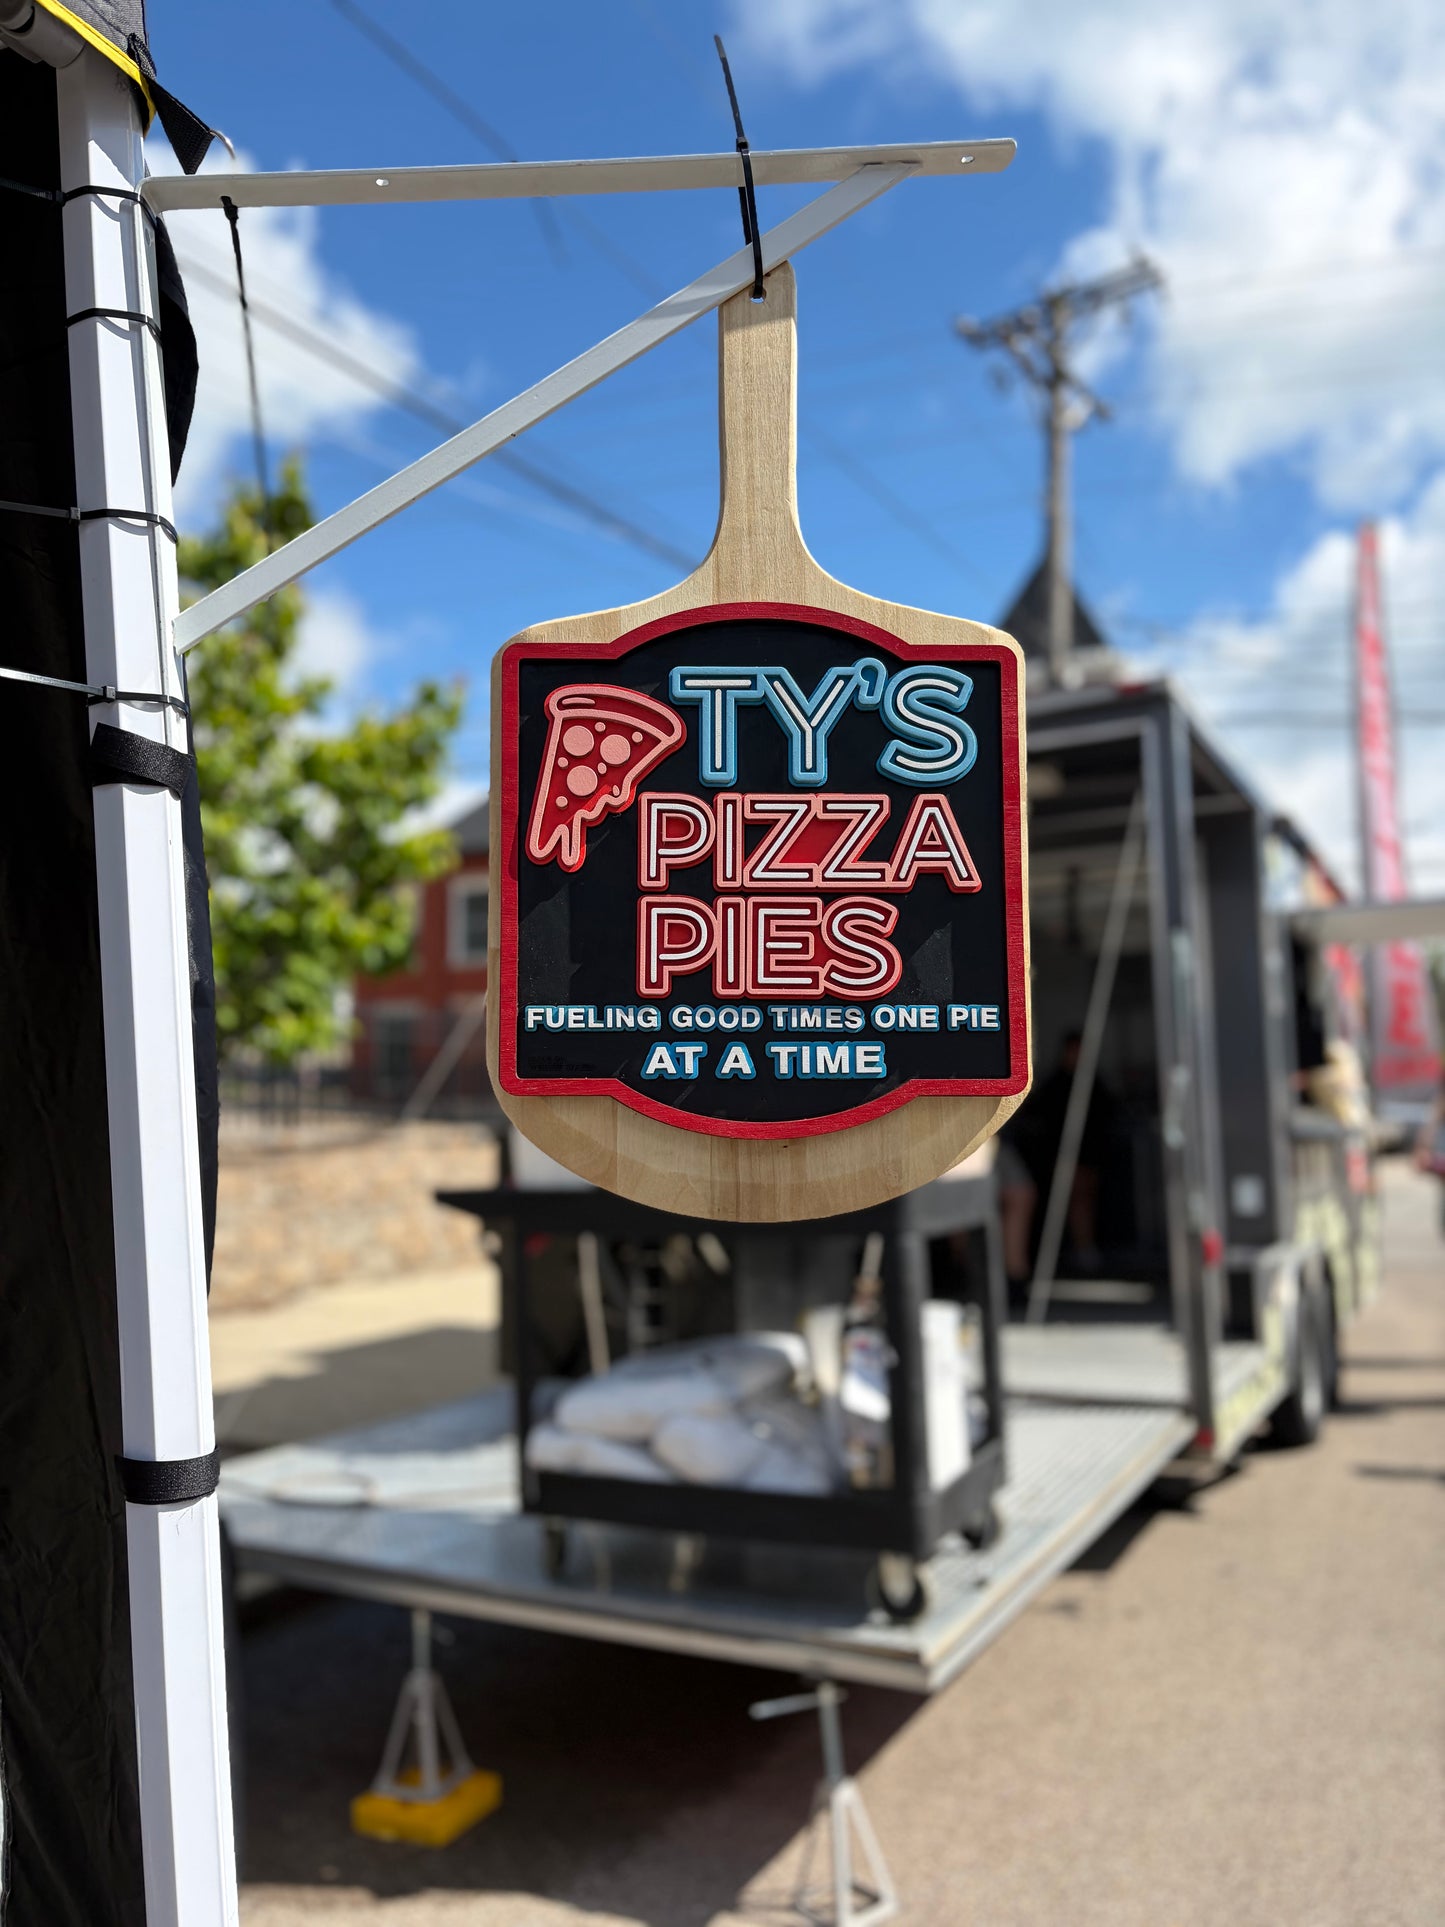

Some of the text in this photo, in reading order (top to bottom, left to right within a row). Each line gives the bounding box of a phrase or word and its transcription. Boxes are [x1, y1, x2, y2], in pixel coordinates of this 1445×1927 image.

[670, 657, 977, 786] TY'S
[638, 793, 981, 891] PIZZA
[637, 896, 902, 998] PIES
[526, 1006, 999, 1030] FUELING GOOD TIMES ONE PIE
[643, 1045, 884, 1076] AT A TIME
